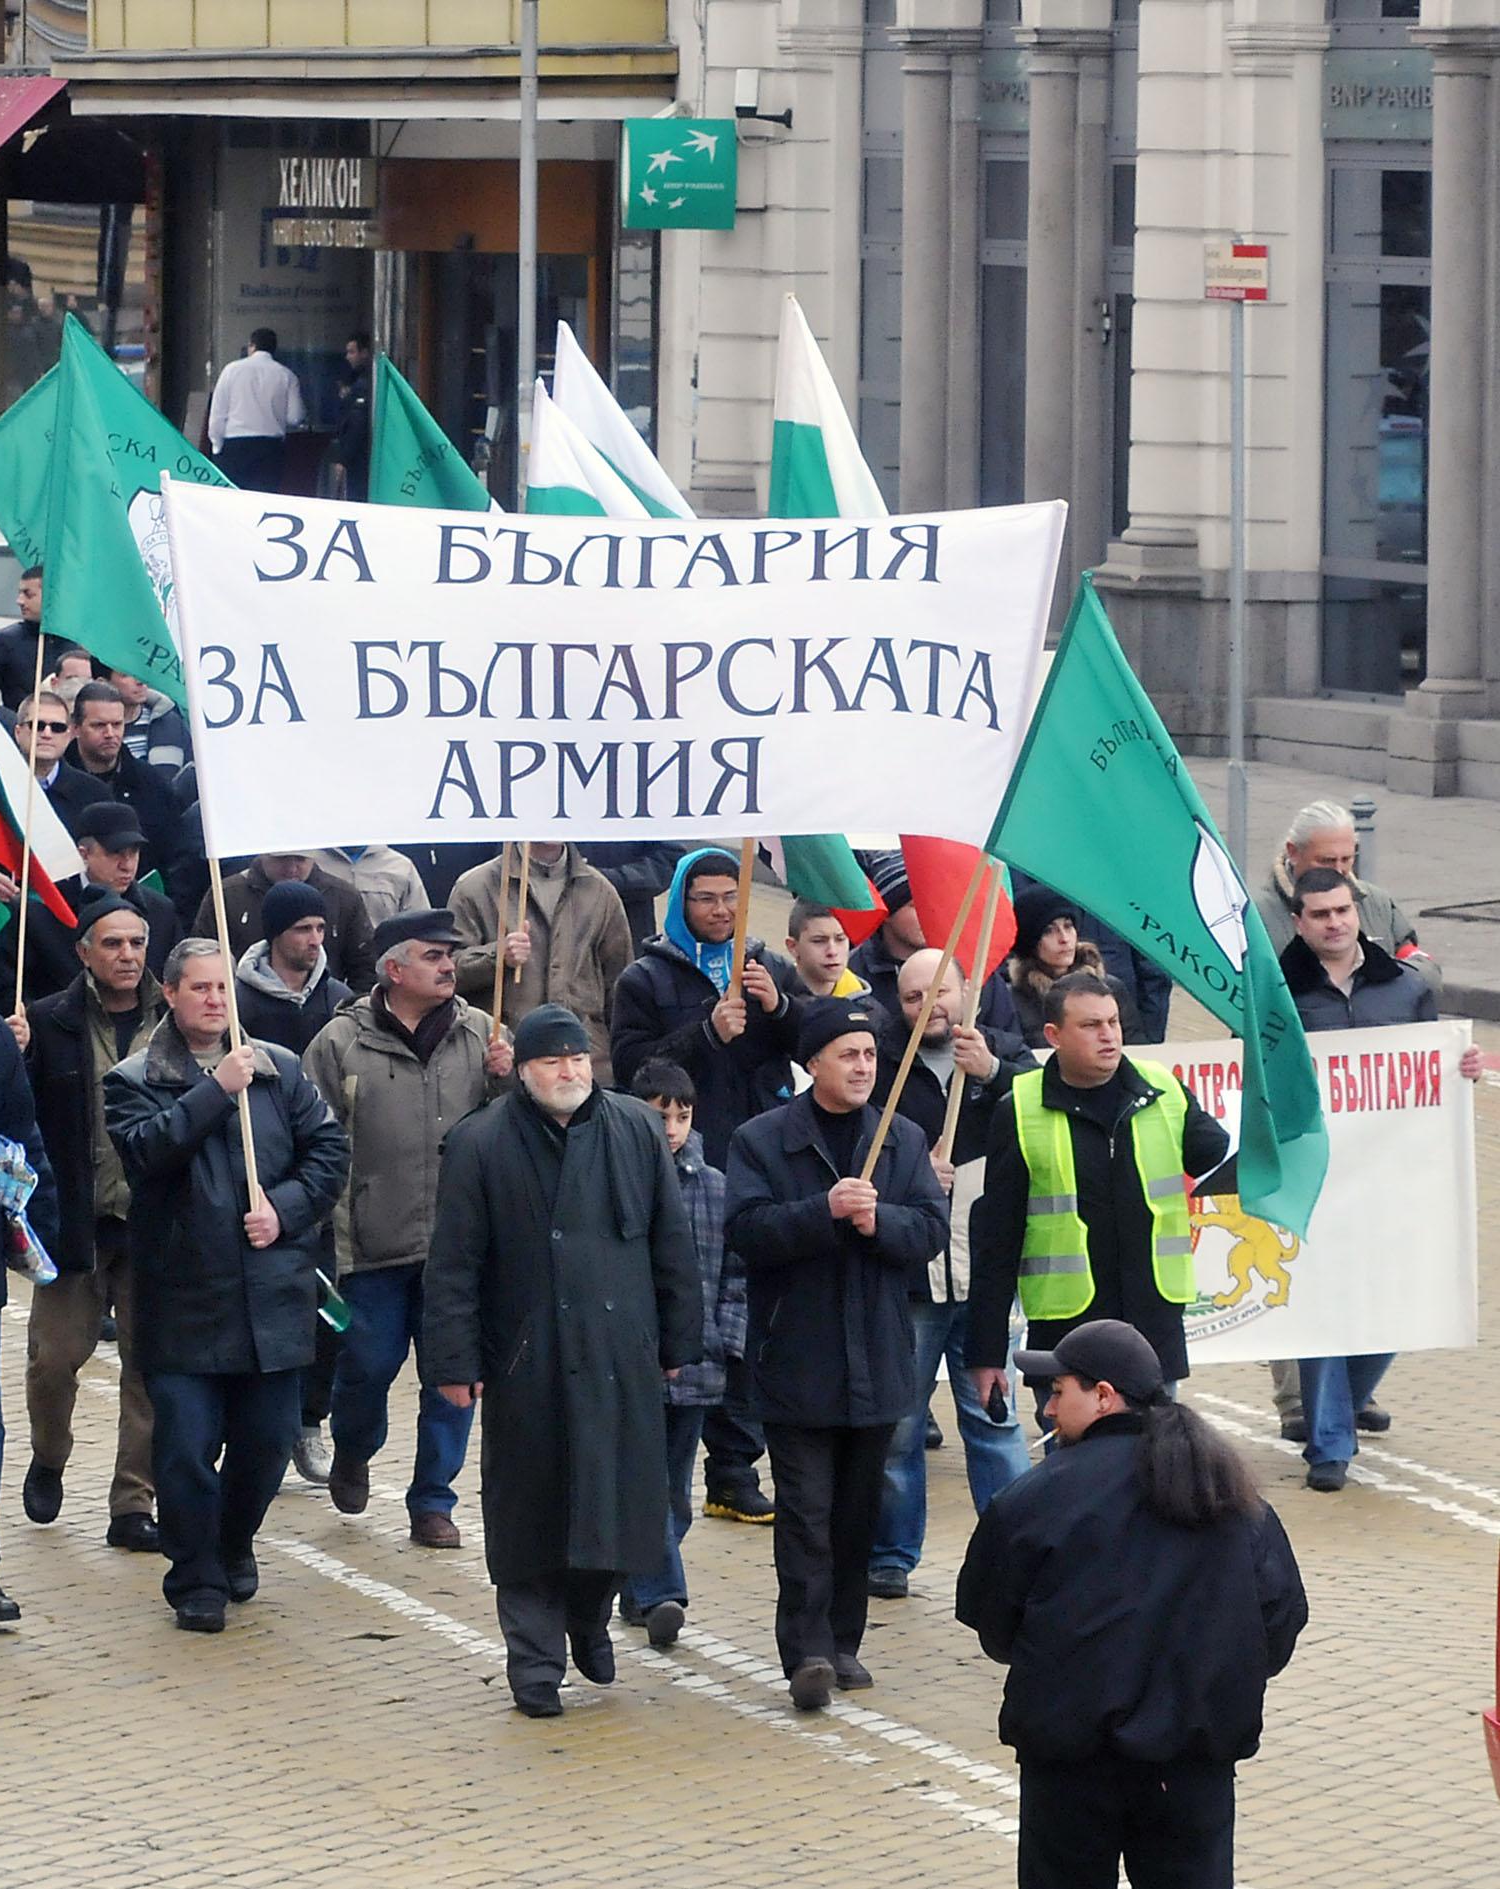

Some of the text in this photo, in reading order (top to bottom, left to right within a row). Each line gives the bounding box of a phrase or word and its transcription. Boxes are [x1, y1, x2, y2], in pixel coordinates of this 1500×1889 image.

[1331, 85, 1373, 108] BNP
[278, 157, 362, 208] ХЕЛИКОН
[256, 514, 941, 590] ЗА БЪЛГАРИЯ
[201, 638, 1003, 733] ЗА БЪЛГАРСКАТА
[428, 738, 764, 822] АРМИЯ
[1329, 1050, 1441, 1113] БЪЛГАРИЯ
